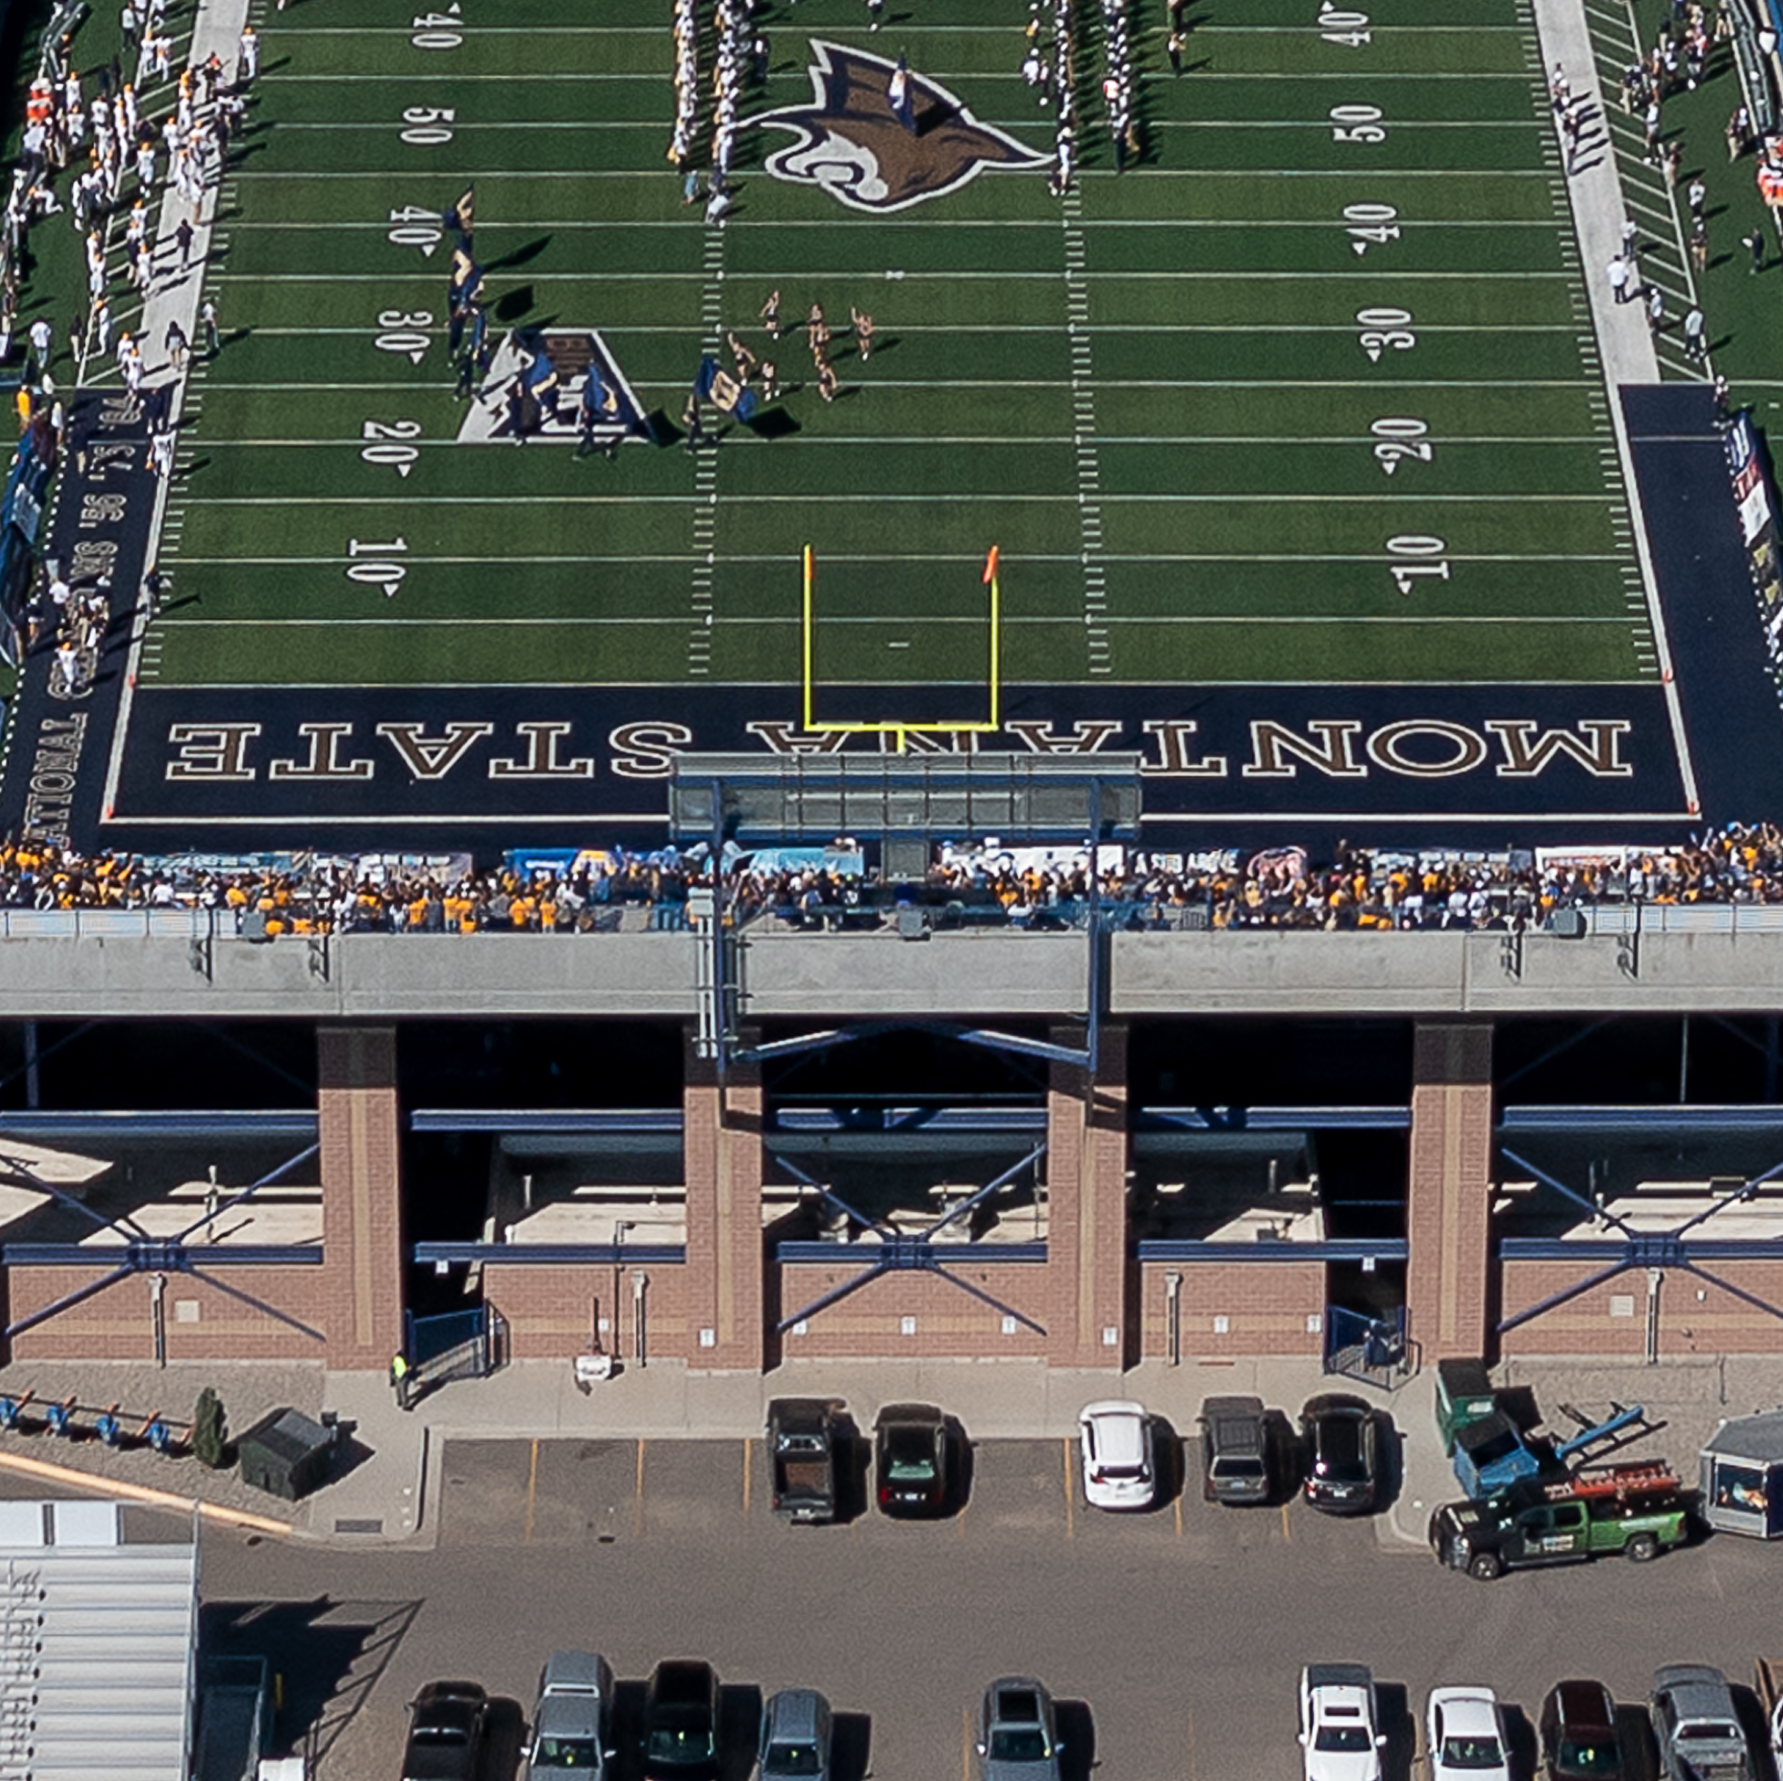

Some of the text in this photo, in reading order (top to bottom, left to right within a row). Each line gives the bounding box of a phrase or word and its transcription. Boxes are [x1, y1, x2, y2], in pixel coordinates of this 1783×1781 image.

[412, 11, 463, 49] 40
[1318, 8, 1371, 48] 40
[400, 107, 456, 146] 50
[1330, 104, 1387, 144] 50
[388, 205, 443, 248] 40
[1343, 203, 1401, 245] 40
[374, 309, 433, 352] 30
[1356, 307, 1416, 352] 30
[361, 419, 422, 465] 20
[1371, 417, 1434, 463] 20
[346, 536, 408, 584] 10
[1386, 533, 1451, 582] 10
[165, 721, 693, 781] STATE
[21, 713, 89, 850] ATIONAL
